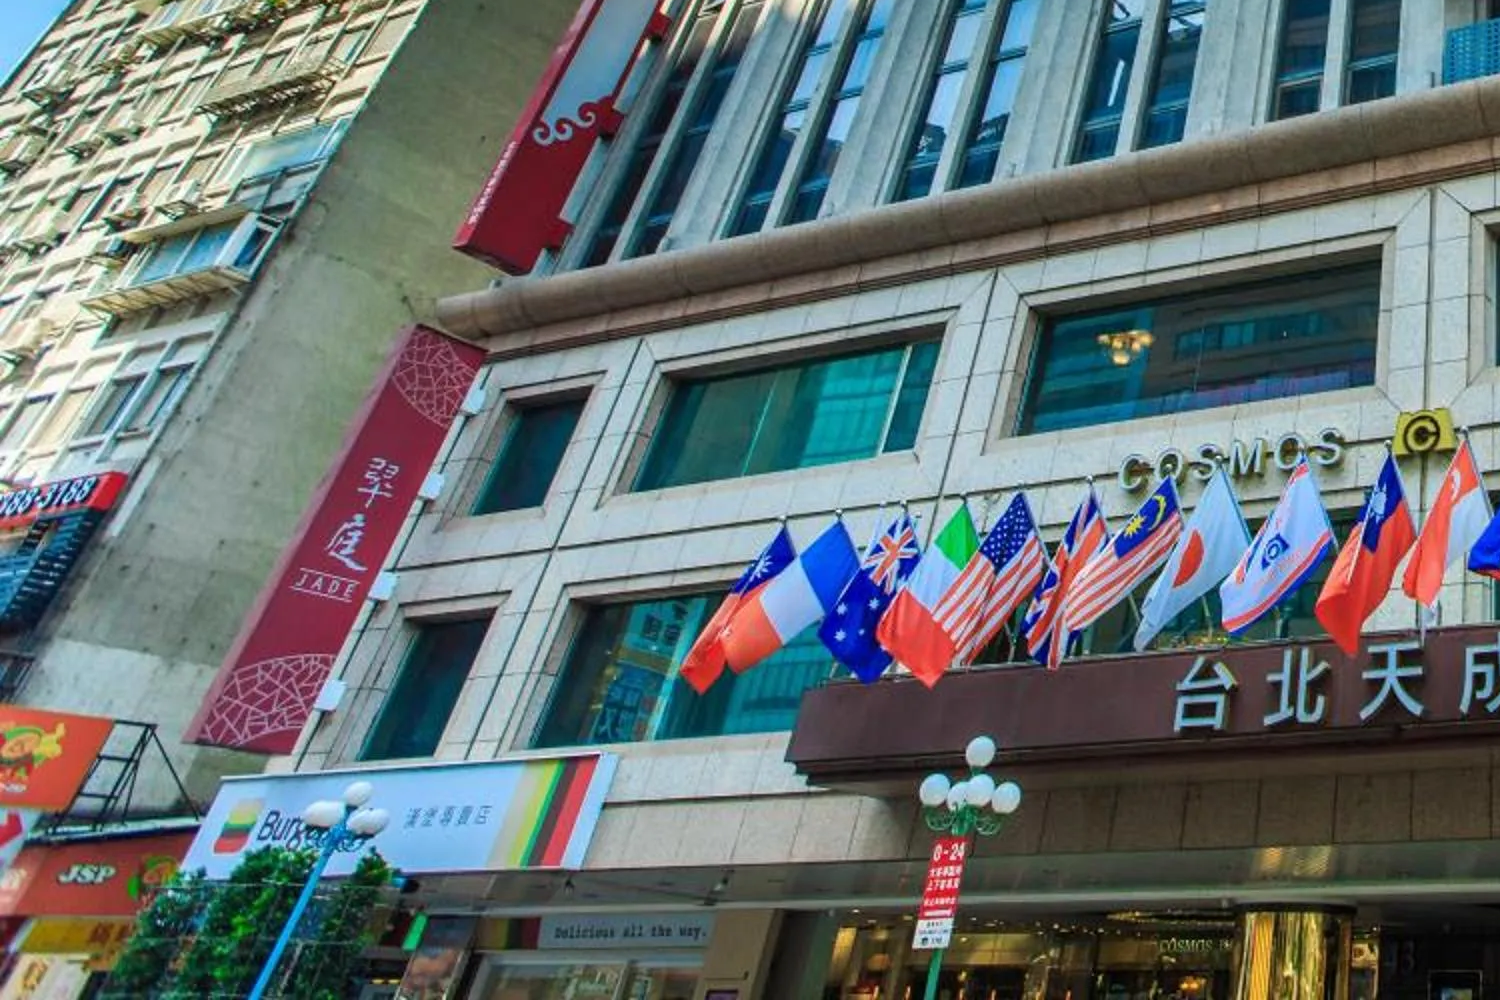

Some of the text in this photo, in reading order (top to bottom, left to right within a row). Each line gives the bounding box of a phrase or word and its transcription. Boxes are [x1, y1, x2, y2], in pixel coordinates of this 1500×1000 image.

[1118, 427, 1345, 493] COSMOS
[295, 572, 358, 599] JADE
[57, 863, 117, 885] JSP
[554, 924, 616, 940] Delicious
[623, 924, 644, 939] all
[651, 924, 674, 938] the
